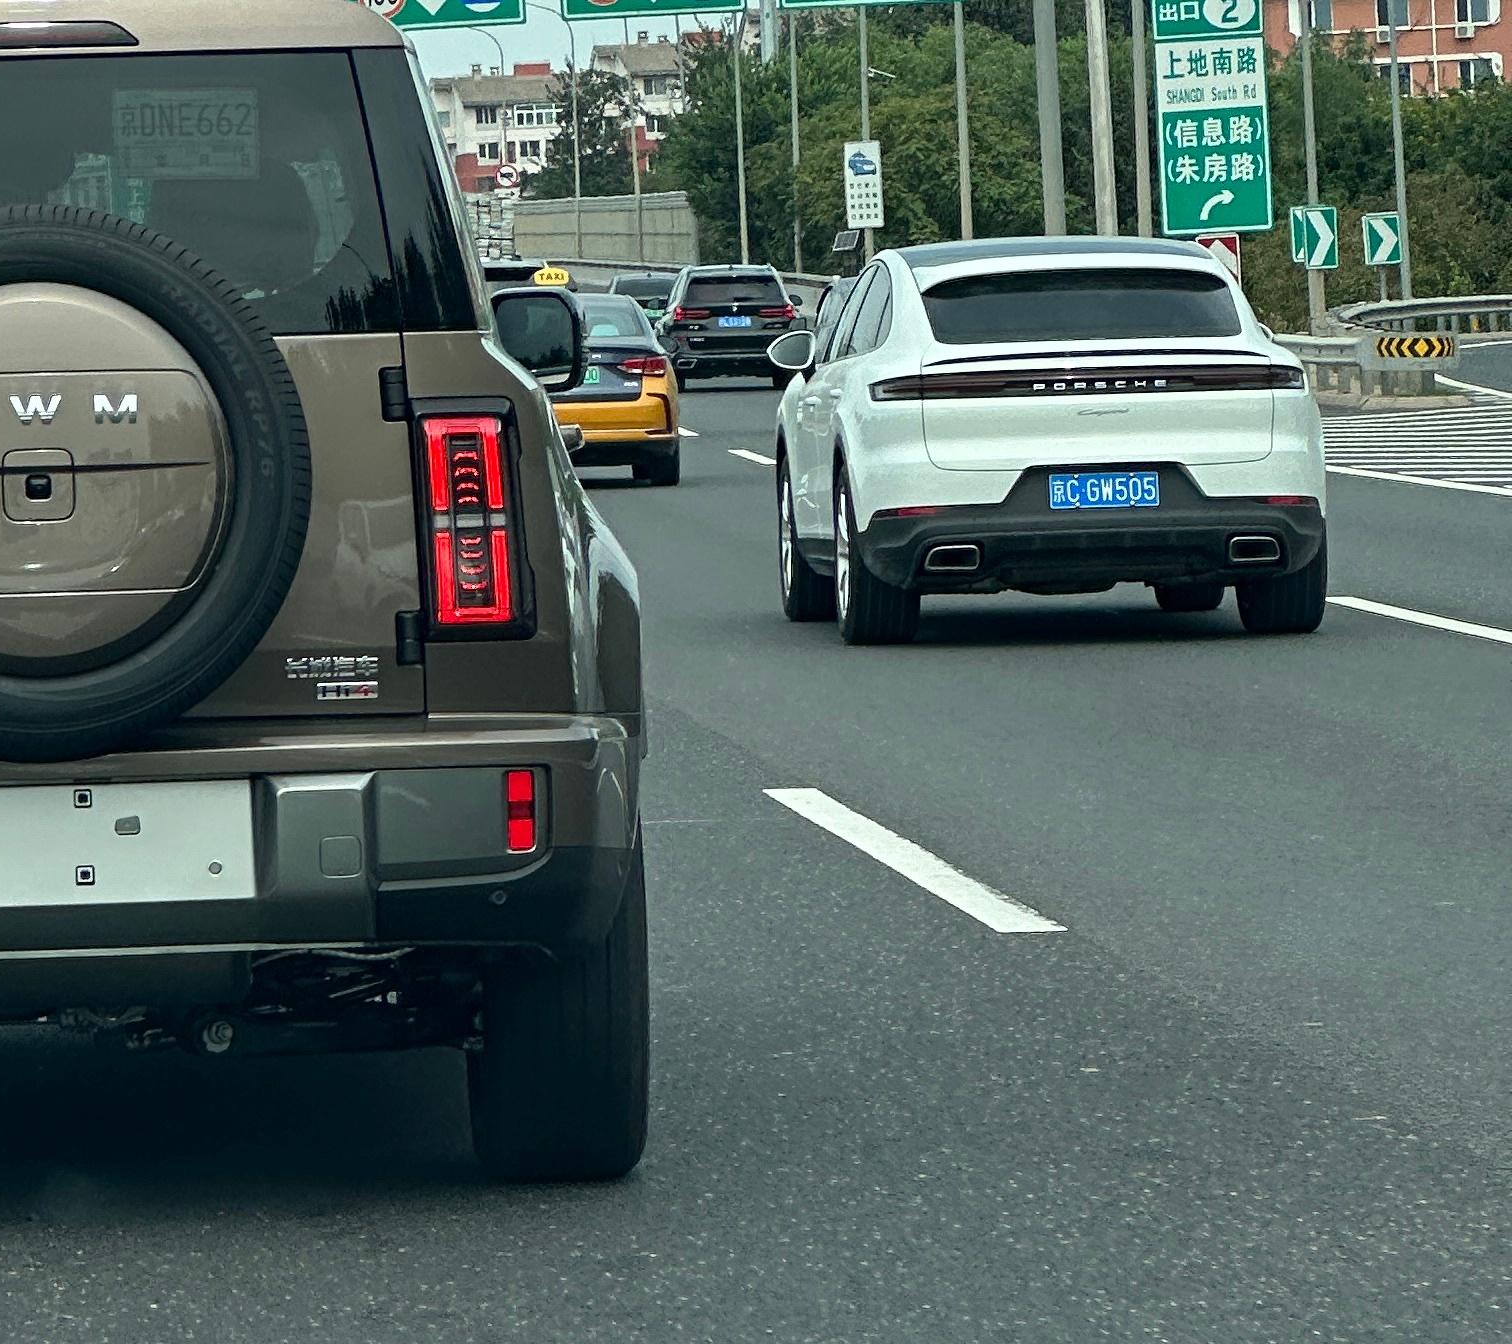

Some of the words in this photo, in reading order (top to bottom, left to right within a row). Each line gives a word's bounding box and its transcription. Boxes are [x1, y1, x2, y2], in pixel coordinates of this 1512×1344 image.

[1159, 0, 1200, 22] 出口
[1162, 47, 1257, 80] 上地南路
[1211, 85, 1237, 102] South
[1243, 83, 1256, 100] Rd
[1165, 116, 1262, 149] (信息路)
[1168, 152, 1264, 184] (朱房路)
[539, 272, 565, 281] TAXI
[1032, 379, 1167, 391] PORSCHE
